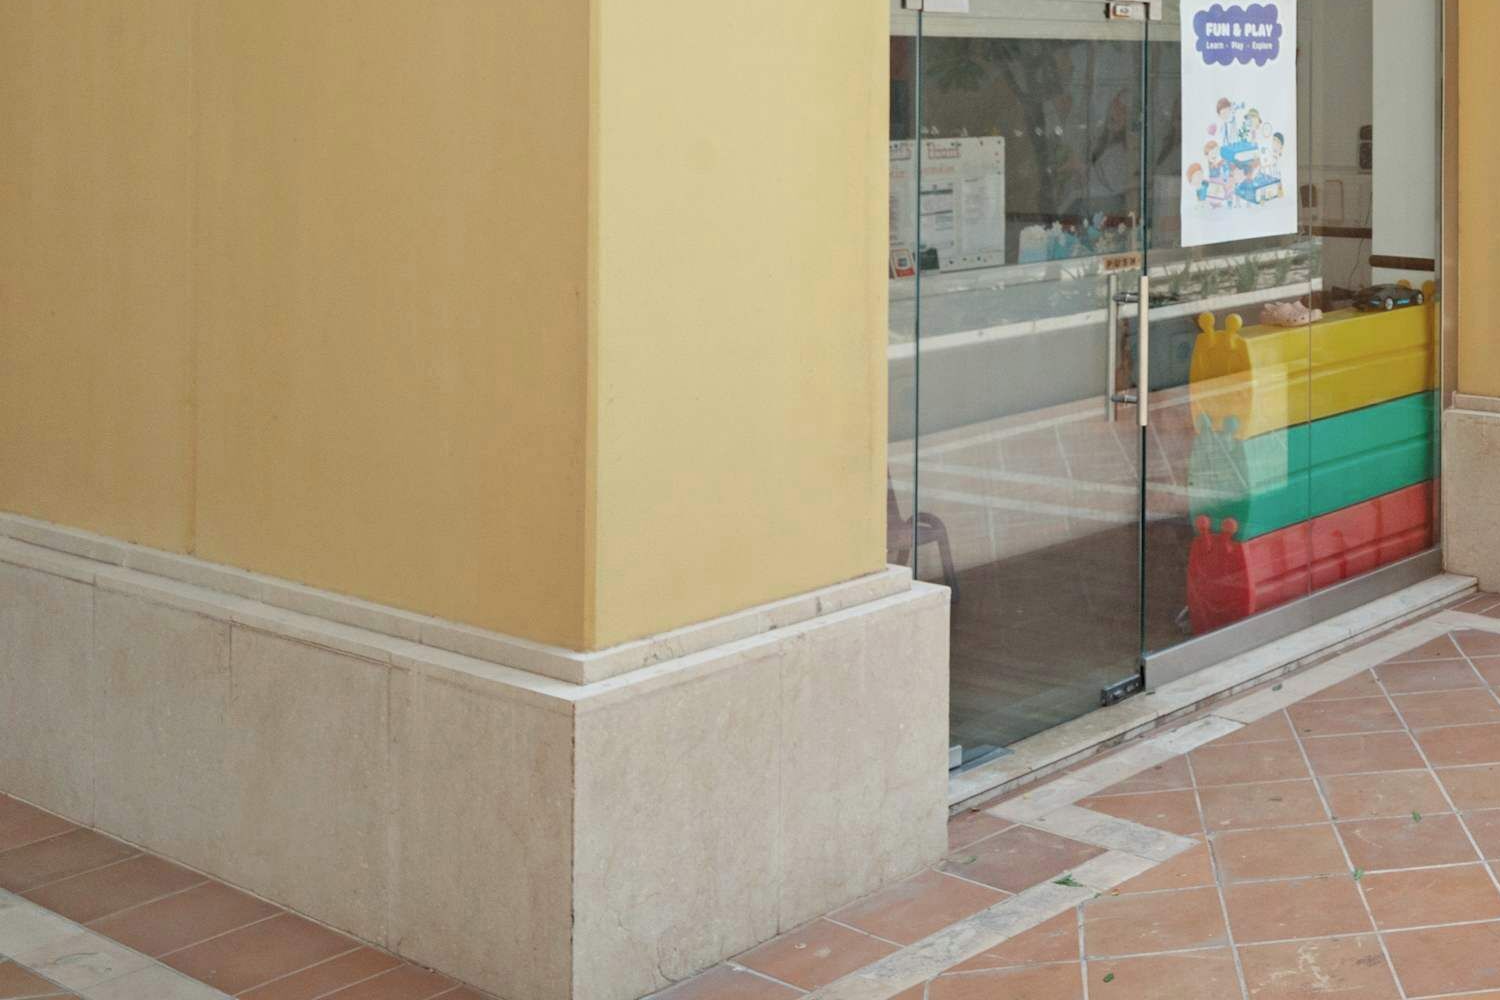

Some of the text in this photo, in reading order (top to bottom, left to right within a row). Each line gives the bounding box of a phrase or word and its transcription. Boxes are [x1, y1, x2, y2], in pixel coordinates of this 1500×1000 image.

[1205, 22, 1273, 38] FUN & PLAY
